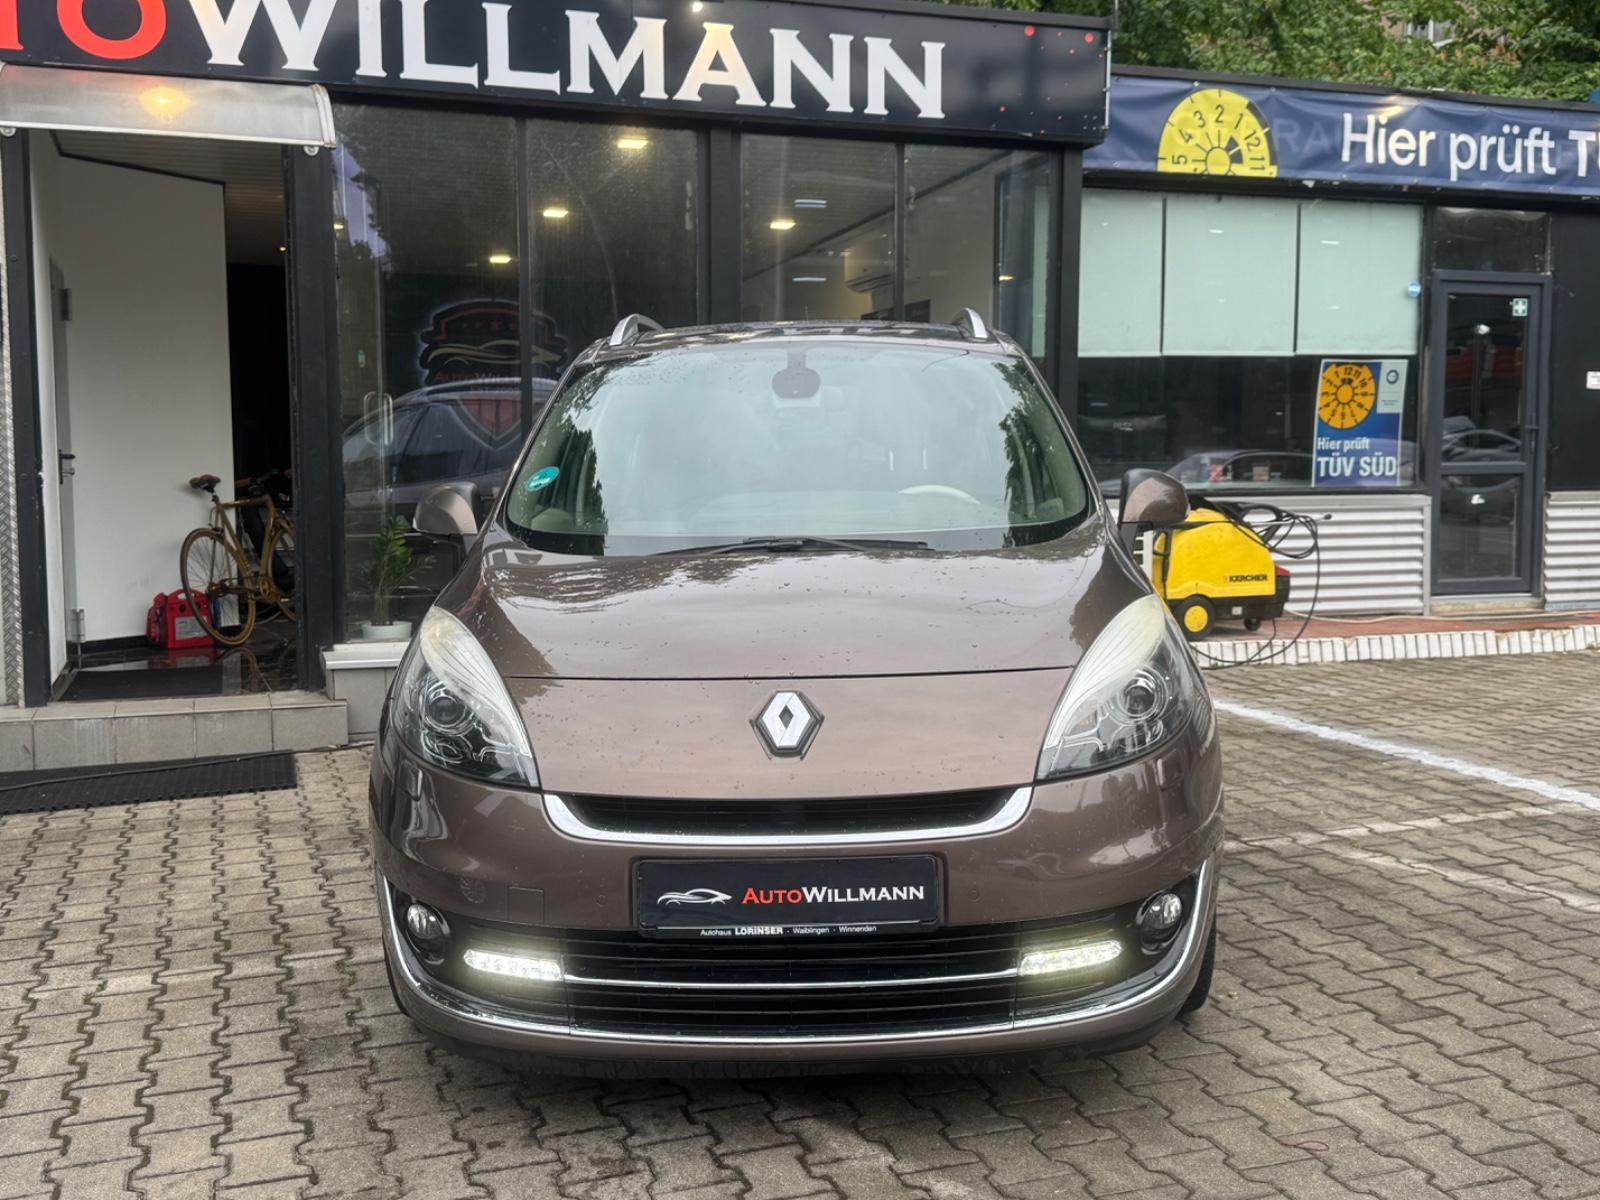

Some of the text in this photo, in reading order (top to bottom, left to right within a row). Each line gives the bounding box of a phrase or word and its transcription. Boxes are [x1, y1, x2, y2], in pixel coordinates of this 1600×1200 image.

[0, 0, 946, 119] OWILLMANN
[1193, 110, 1206, 128] 3
[1215, 104, 1225, 123] 2
[1234, 113, 1244, 130] 1
[1179, 130, 1193, 144] 4
[1244, 130, 1261, 152] 12
[1341, 112, 1437, 168] Hier
[1448, 123, 1558, 182] prüft
[1567, 129, 1600, 177] T
[1171, 155, 1188, 165] 5
[1249, 157, 1265, 171] 11
[1317, 436, 1370, 453] Hier prüft
[1317, 451, 1396, 477] TÜV SÜD
[700, 925, 877, 937] Autohaus LORINSER Waiblingen Winnenden
